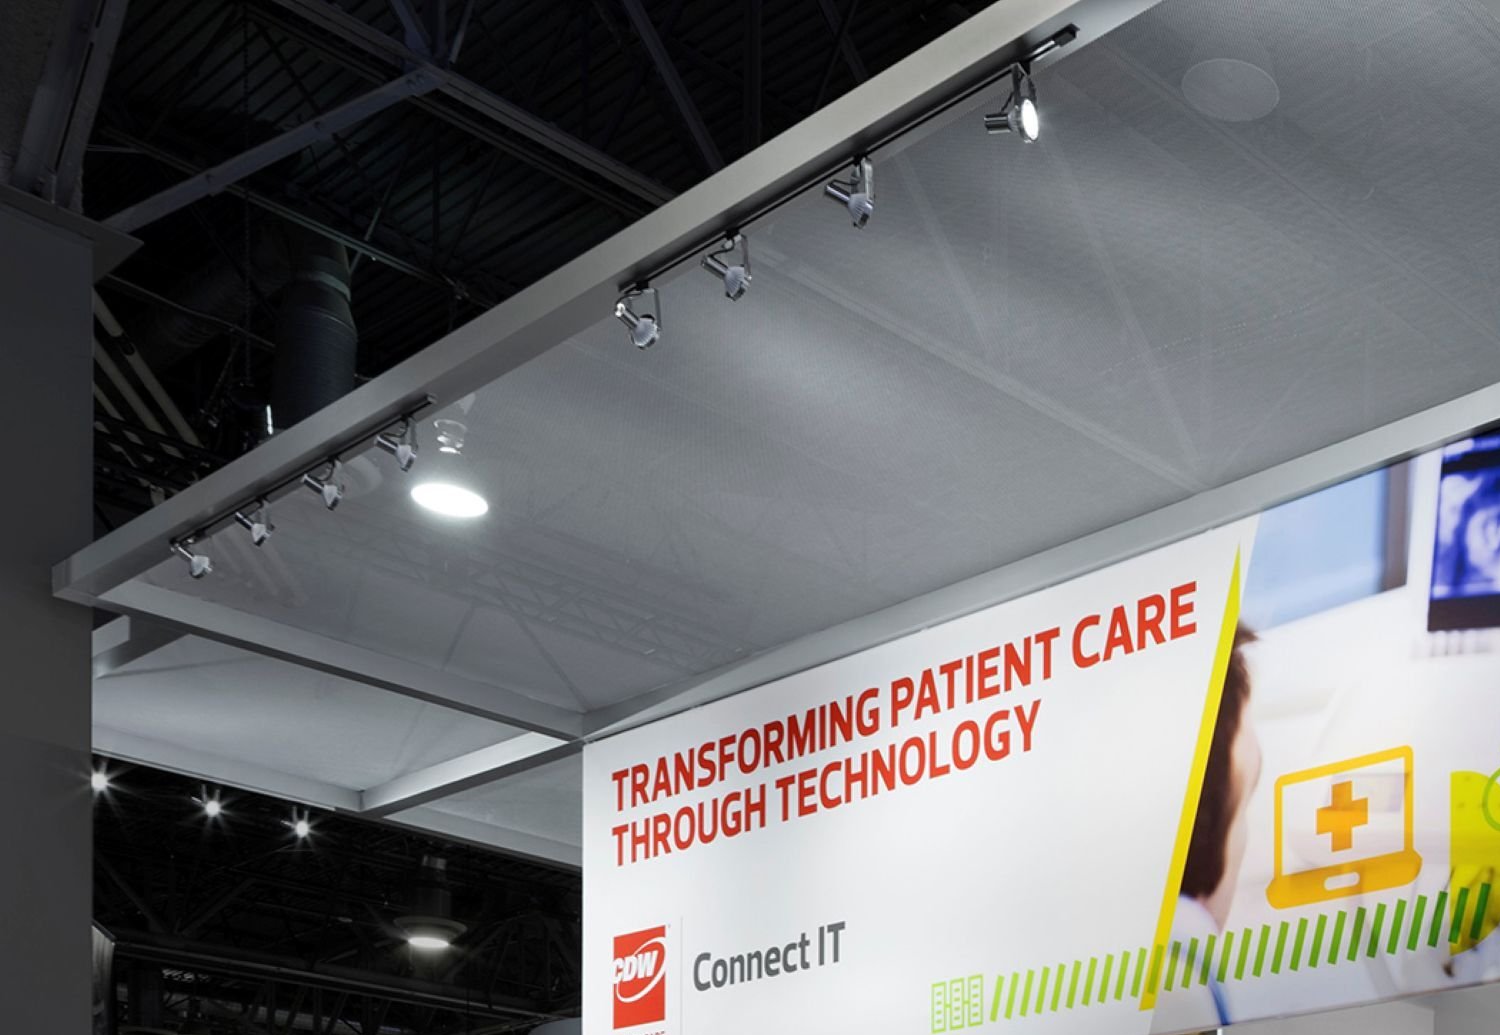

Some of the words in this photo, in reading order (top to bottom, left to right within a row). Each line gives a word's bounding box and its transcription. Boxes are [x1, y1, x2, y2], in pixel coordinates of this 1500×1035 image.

[612, 687, 880, 812] TRANSFORMING
[890, 626, 1061, 729] PATIENT
[1072, 580, 1198, 669] CARE
[612, 783, 767, 867] THROUGH
[775, 699, 1042, 822] TECHNOLOGY
[612, 949, 659, 985] CDW
[693, 932, 811, 992] Connect
[818, 921, 846, 966] IT
